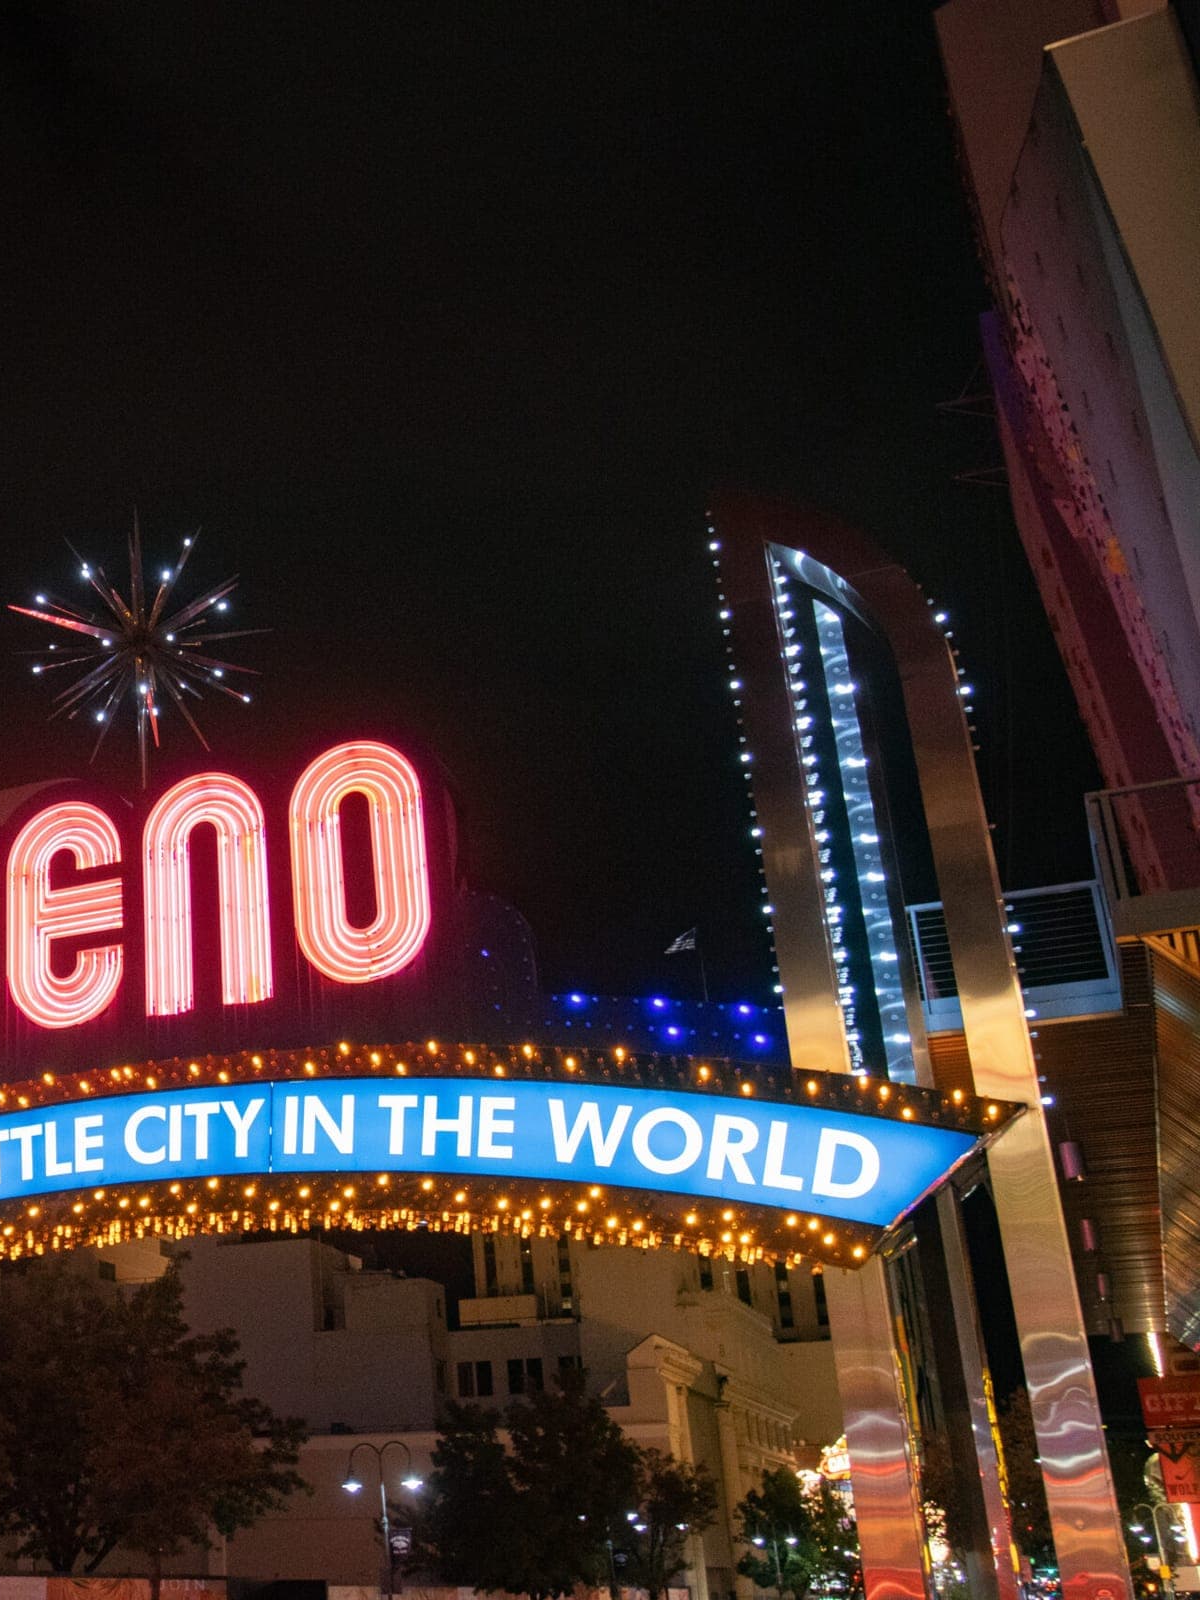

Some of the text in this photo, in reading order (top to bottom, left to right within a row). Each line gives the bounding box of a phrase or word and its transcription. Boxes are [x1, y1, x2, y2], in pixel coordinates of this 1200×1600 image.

[124, 1097, 265, 1166] CITY
[283, 1095, 355, 1155] IN
[378, 1095, 516, 1160] THE
[547, 1098, 881, 1200] WORLD
